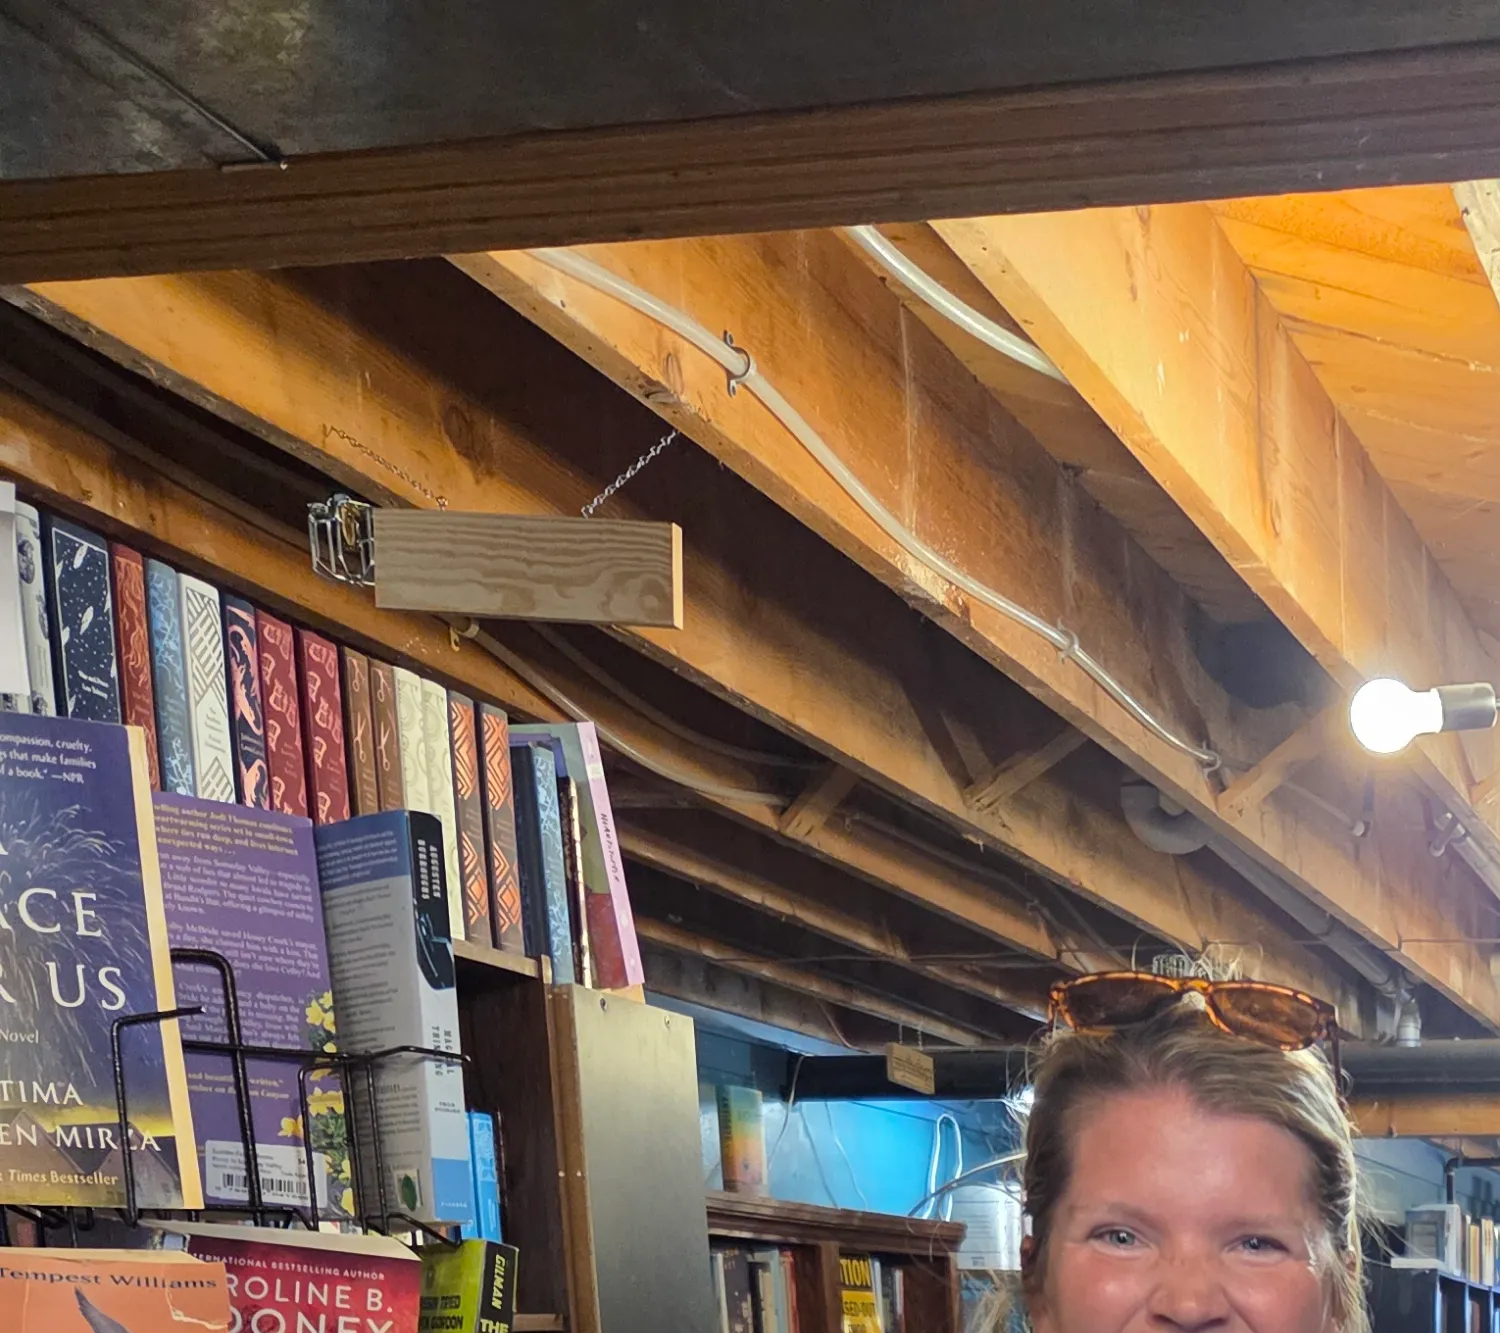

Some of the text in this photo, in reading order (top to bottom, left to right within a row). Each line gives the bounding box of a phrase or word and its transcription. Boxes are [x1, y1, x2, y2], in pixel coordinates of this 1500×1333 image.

[32, 752, 57, 765] make
[60, 754, 97, 770] families
[46, 961, 127, 1011] US
[0, 1029, 39, 1044] Novel
[9, 1168, 119, 1187] Times Bestseller
[0, 1266, 218, 1290] Tempest Williams
[270, 1261, 341, 1278] BESTSELLING
[342, 1268, 386, 1282] AUTHOR
[490, 1253, 507, 1311] GILMAN
[226, 1272, 394, 1314] ROLINE B.
